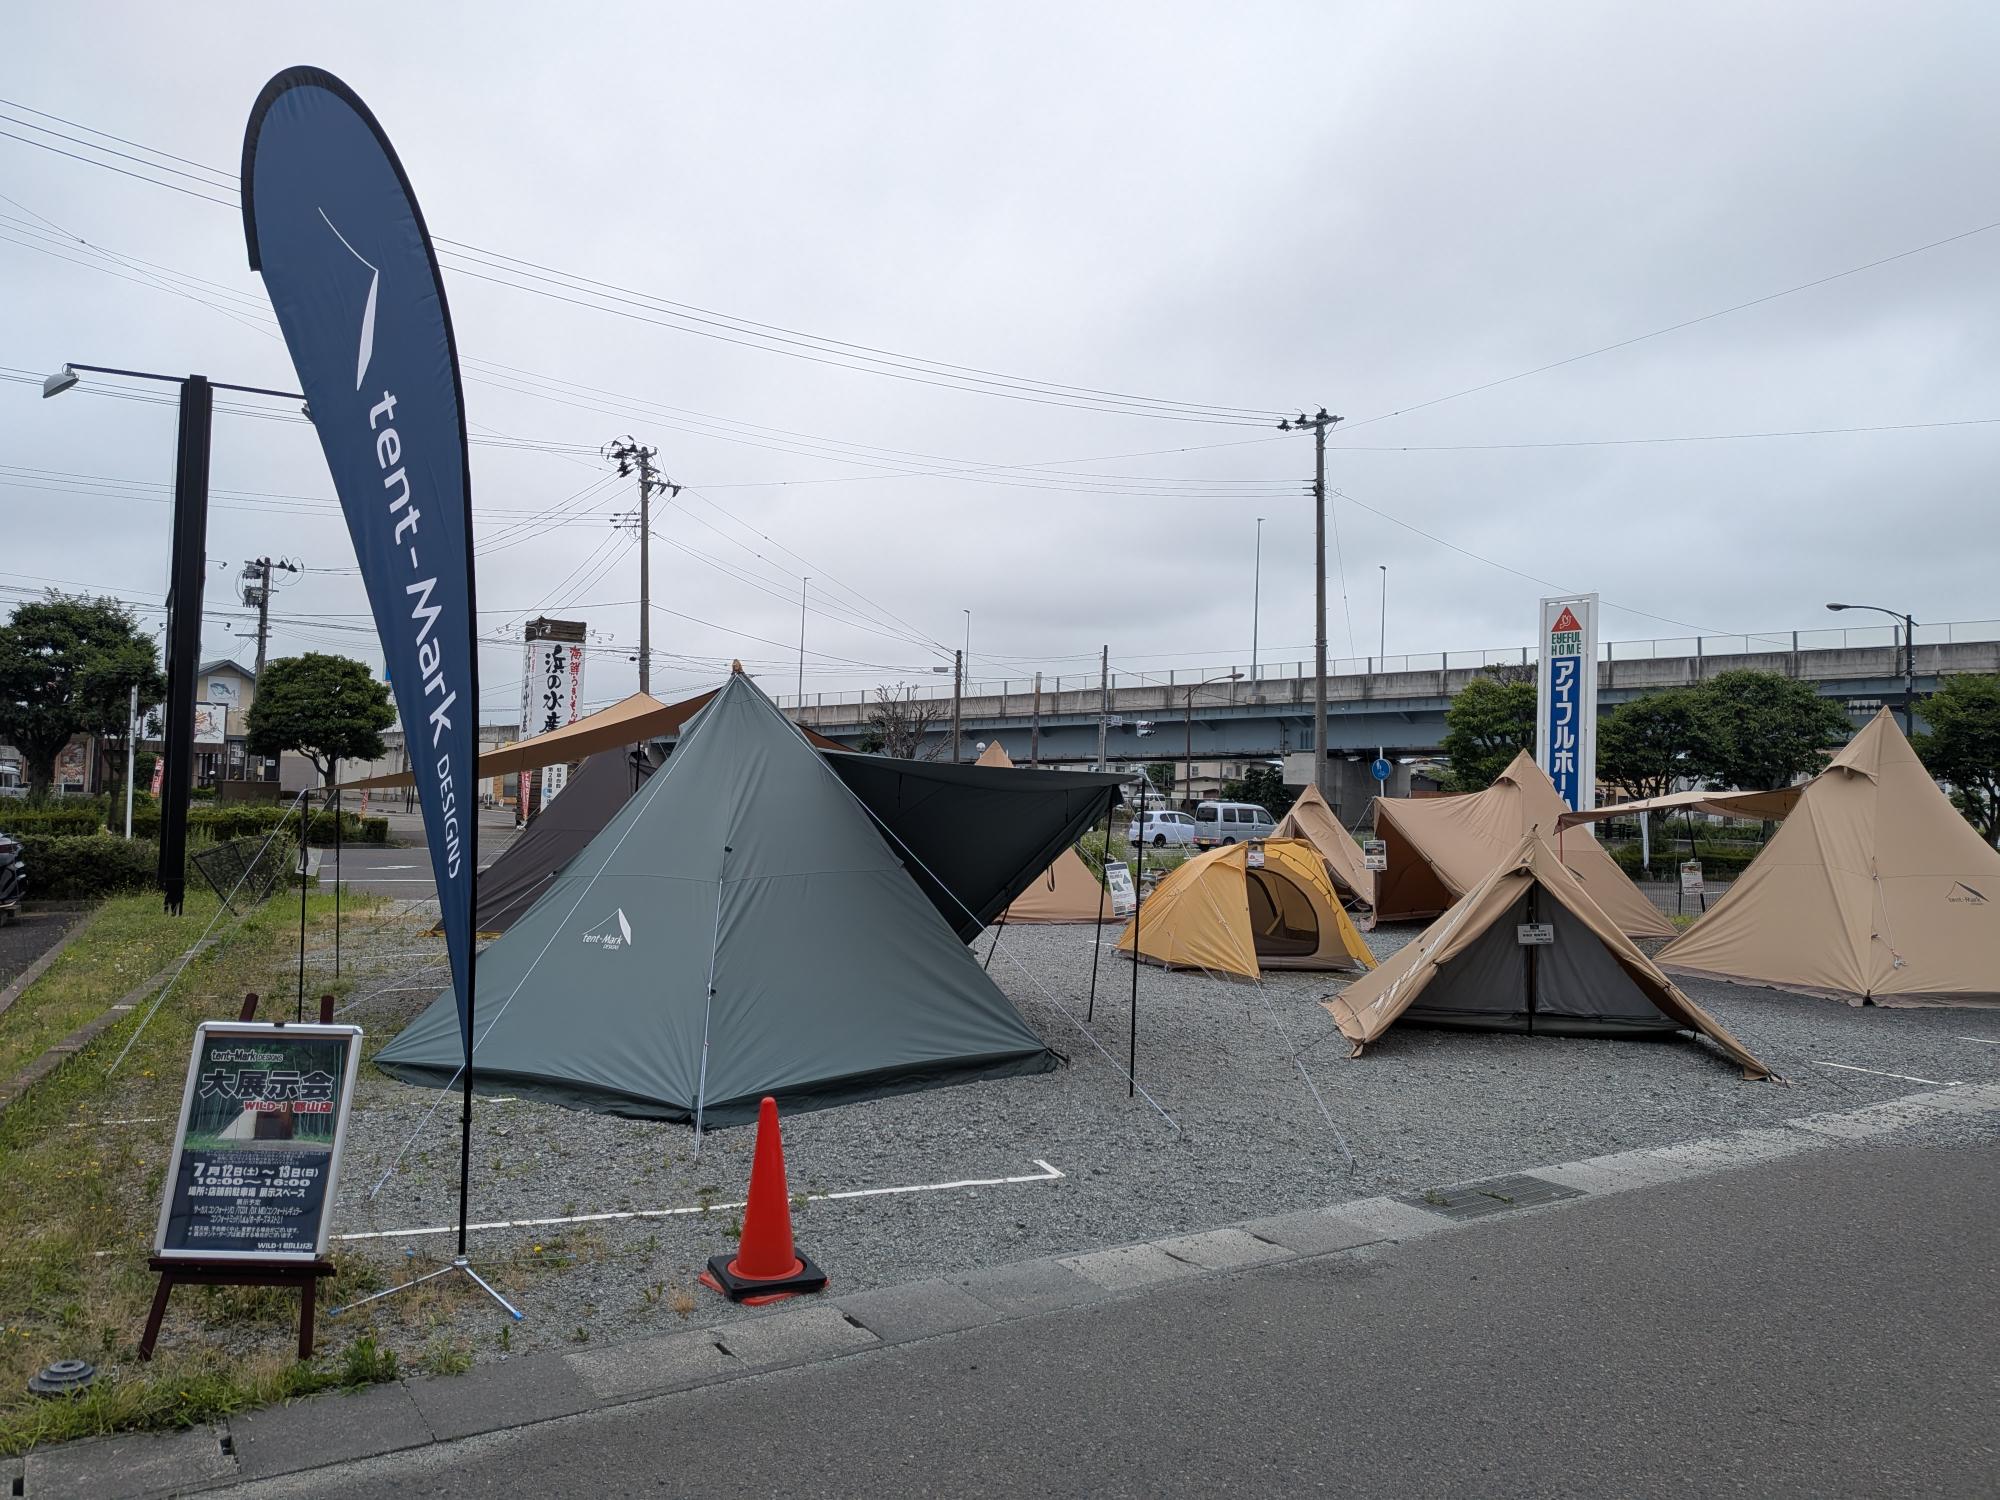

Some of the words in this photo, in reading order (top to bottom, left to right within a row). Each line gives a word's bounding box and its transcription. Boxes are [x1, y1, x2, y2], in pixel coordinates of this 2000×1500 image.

[369, 390, 457, 749] tent-Mark
[436, 753, 461, 880] DESIGNS
[1552, 644, 1581, 655] HOME
[200, 1068, 335, 1101] 大展示会
[244, 1101, 288, 1112] WILD-1
